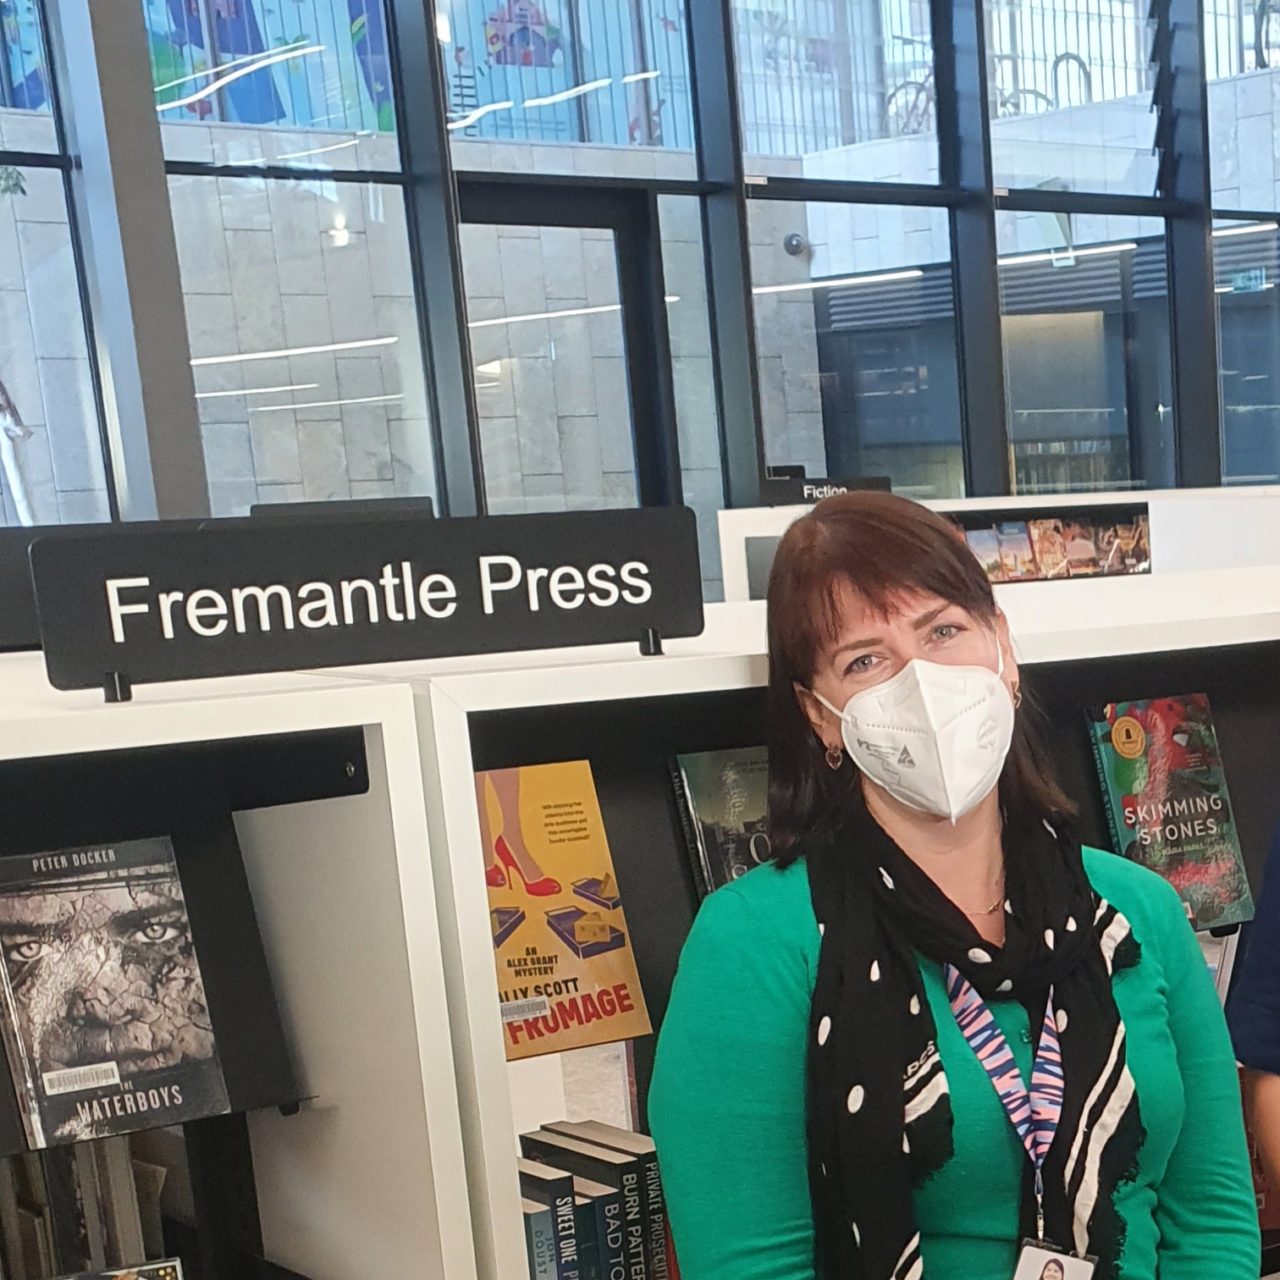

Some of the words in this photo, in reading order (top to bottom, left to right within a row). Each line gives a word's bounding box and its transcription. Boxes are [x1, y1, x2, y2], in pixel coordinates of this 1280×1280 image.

[803, 484, 848, 498] Fiction
[105, 560, 458, 643] Fremantle
[479, 555, 653, 615] Press
[1124, 793, 1223, 825] SKIMMING
[1140, 817, 1218, 846] STONES
[32, 855, 68, 873] PETER
[72, 849, 116, 867] DOCKER
[506, 958, 529, 969] ALEX
[525, 946, 538, 957] AN
[514, 965, 555, 978] MYSTERY
[533, 977, 579, 998] SCOTT
[75, 1085, 184, 1123] WATERBOYS
[622, 1173, 641, 1221] BURN
[646, 1162, 661, 1212] PRIVATE
[555, 1196, 575, 1237] SWEET
[605, 1203, 622, 1249] BAD
[535, 1230, 548, 1276] DOUST
[559, 1240, 577, 1265] ONE
